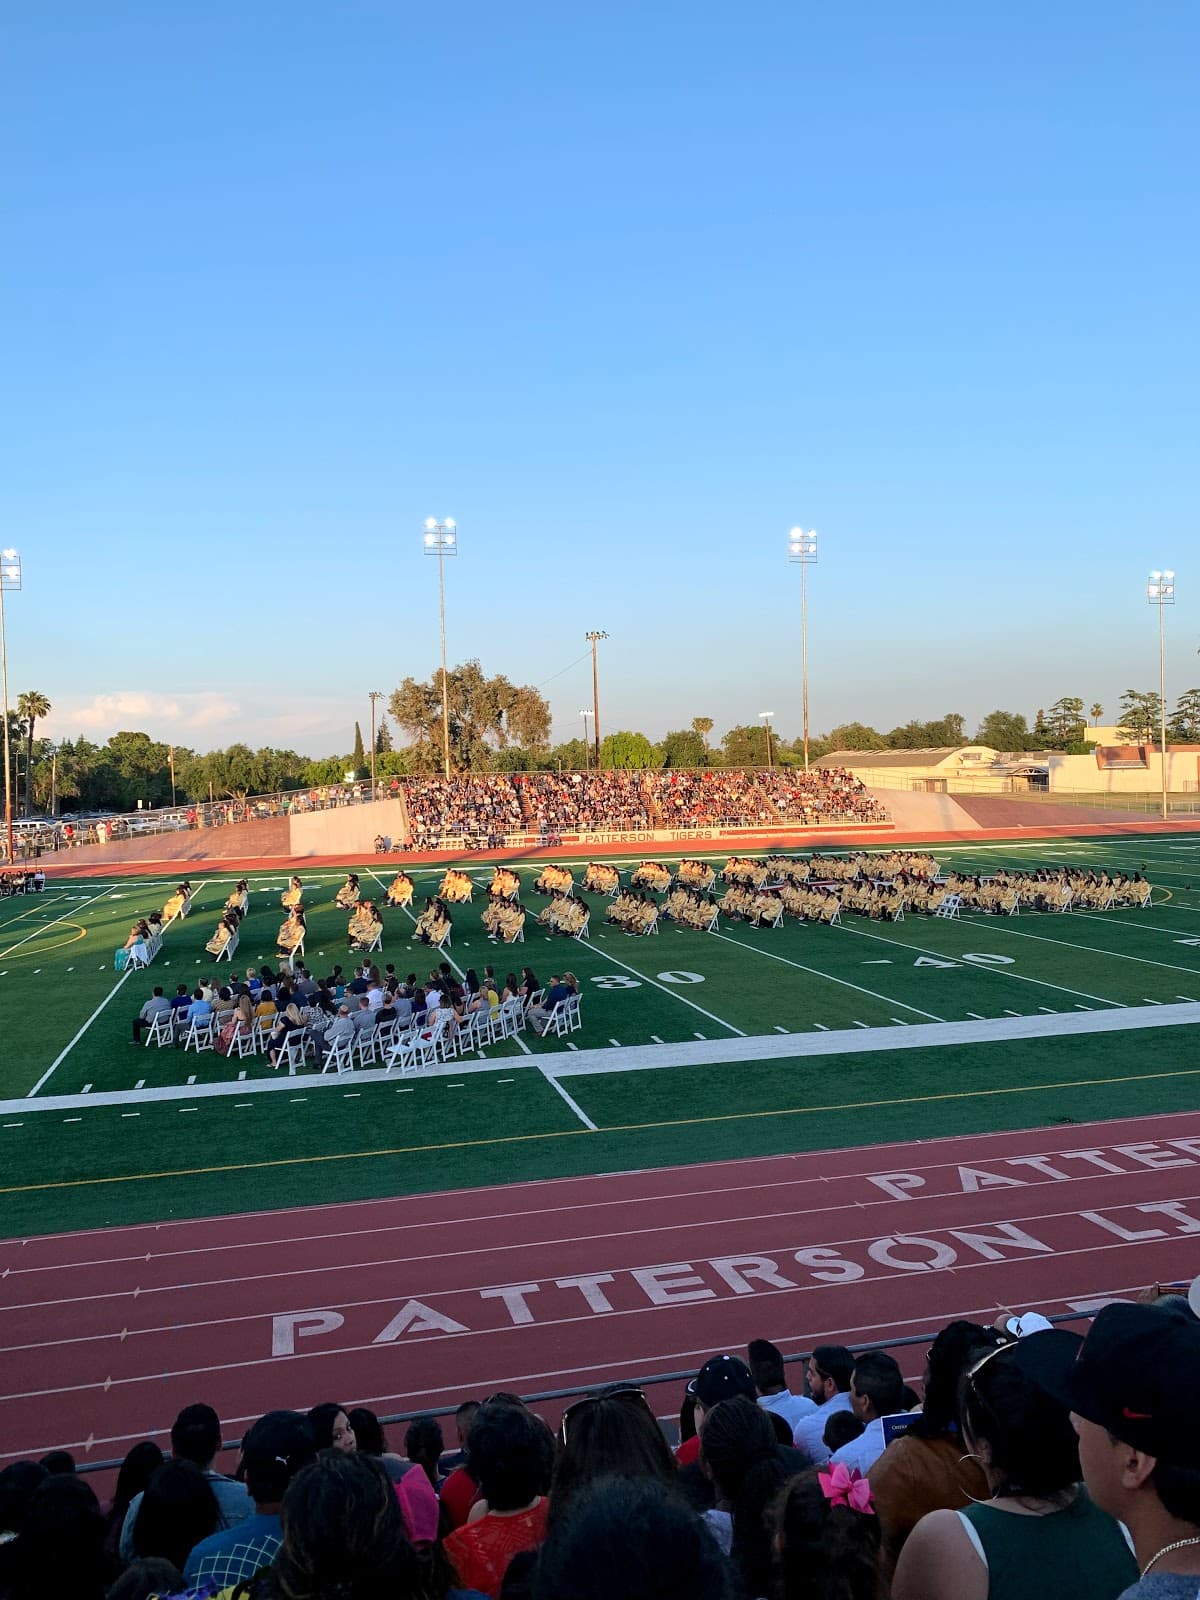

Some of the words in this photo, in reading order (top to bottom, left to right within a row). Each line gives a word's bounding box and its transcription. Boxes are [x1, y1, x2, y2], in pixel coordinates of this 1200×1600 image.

[585, 832, 655, 844] PATTERSON
[670, 830, 712, 841] TIGERS
[913, 953, 1016, 969] 40
[589, 971, 706, 989] 30
[270, 1223, 1056, 1358] PATTERSON
